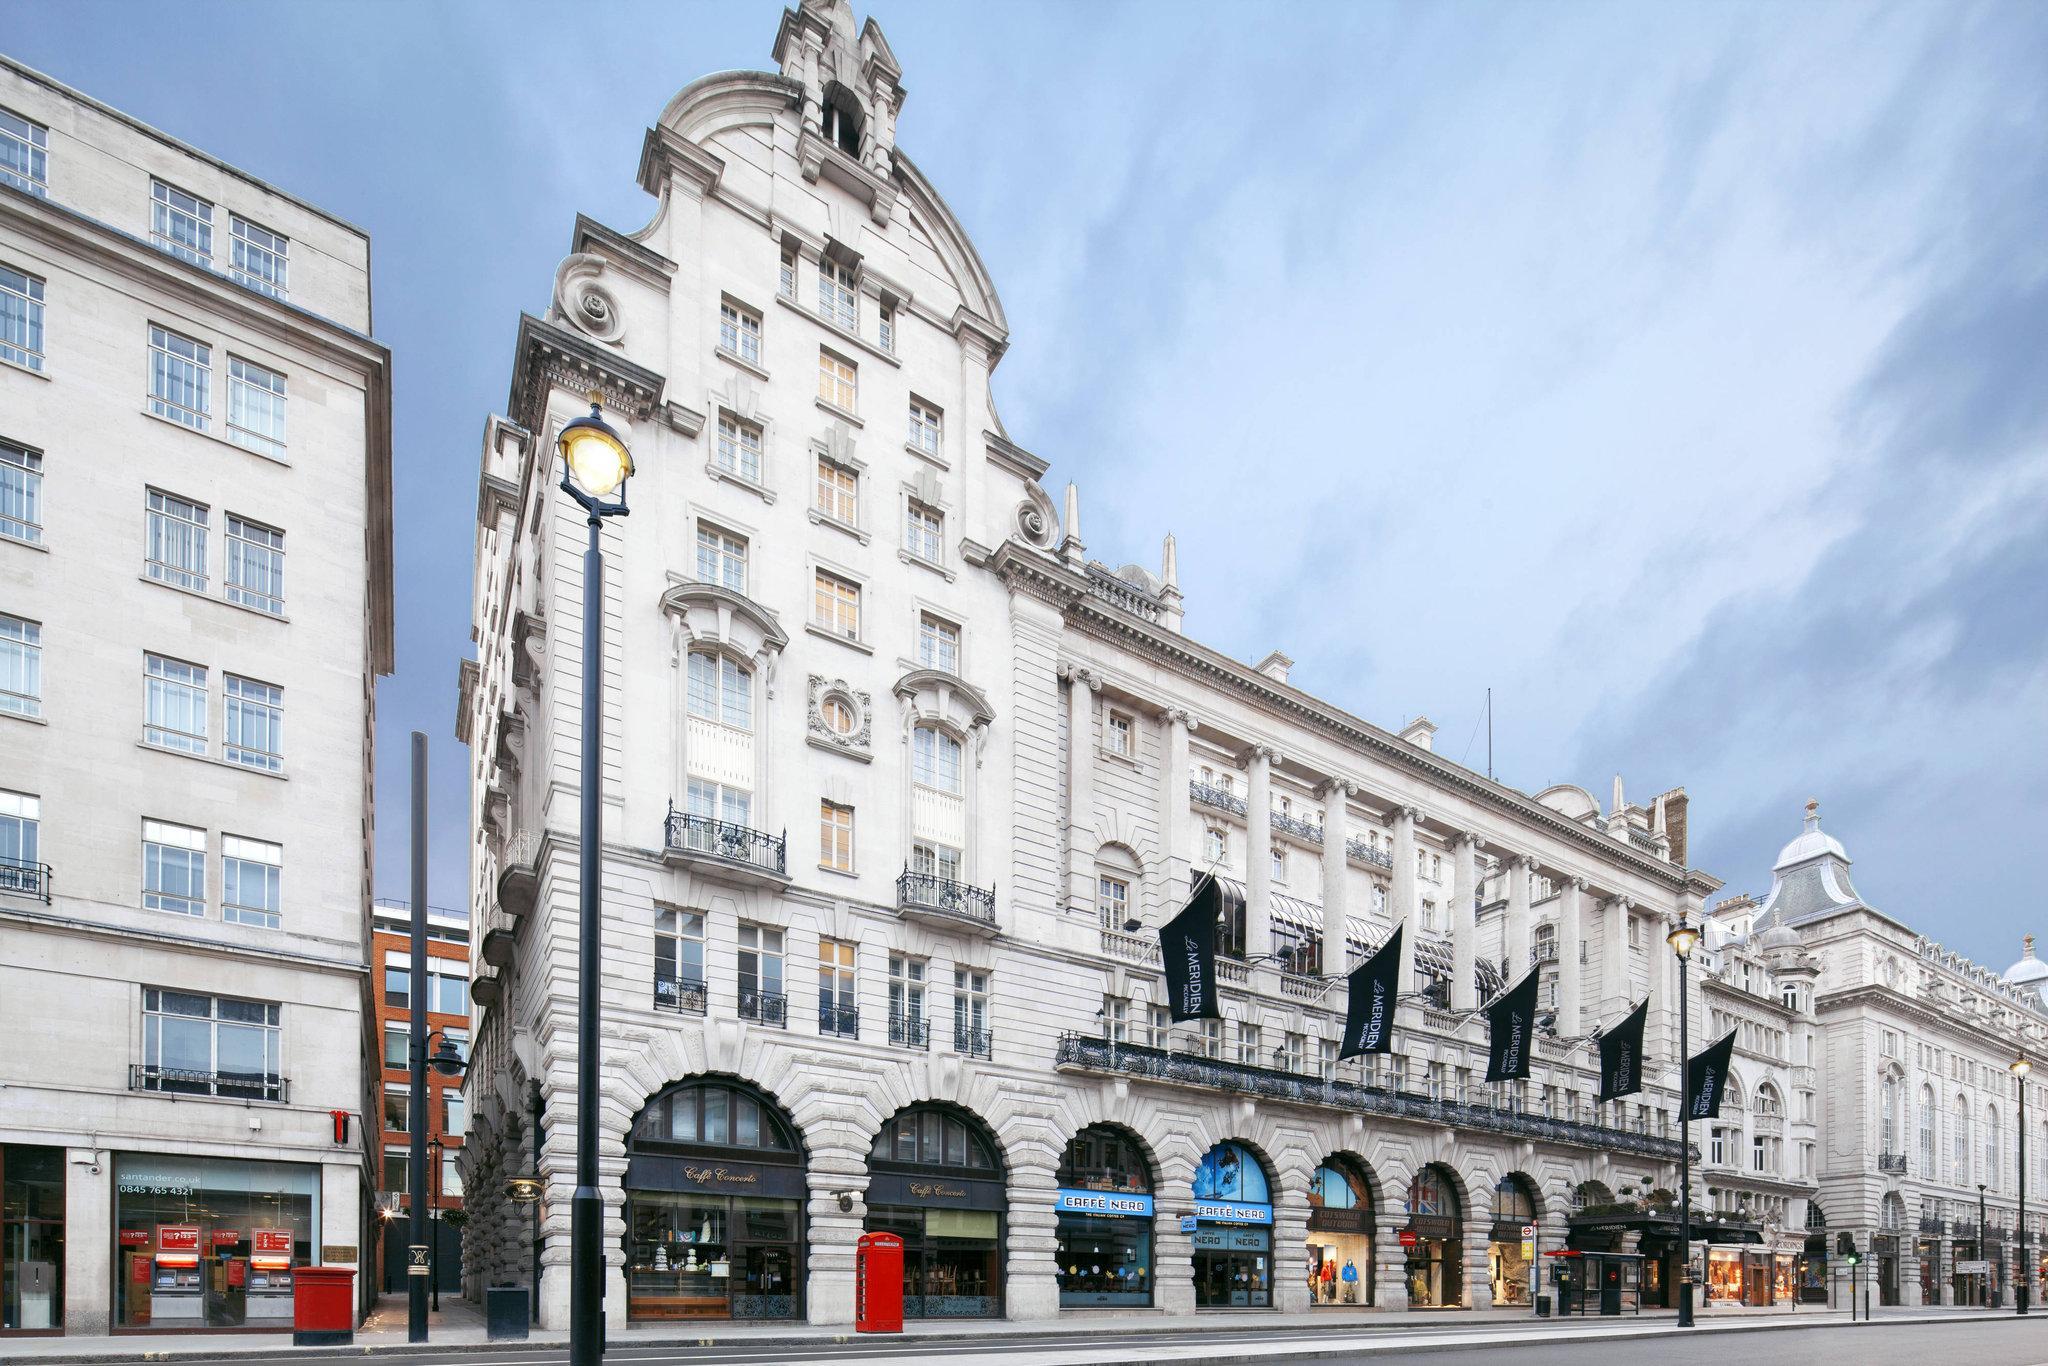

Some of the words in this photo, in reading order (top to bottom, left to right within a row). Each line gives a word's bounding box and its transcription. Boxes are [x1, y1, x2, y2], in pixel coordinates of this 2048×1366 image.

[1184, 935, 1198, 951] Le
[1187, 953, 1201, 1013] MERIDIEN
[1373, 979, 1385, 994] Le
[1365, 995, 1384, 1049] MERIDIEN
[1508, 1025, 1522, 1073] MERIDIEN
[1619, 1051, 1630, 1091] MERIDIEN
[1699, 1076, 1714, 1115] MERIDIEN
[120, 1173, 201, 1184] santander.co.uk
[715, 1168, 756, 1183] Concerto
[120, 1185, 146, 1194] 0845
[150, 1186, 167, 1195] 765
[169, 1187, 193, 1196] 4321
[933, 1184, 967, 1197] Concerto
[1110, 1200, 1146, 1211] NERO
[1236, 1208, 1265, 1219] NERO
[1320, 1210, 1361, 1220] COTSWOLD
[1194, 1235, 1220, 1245] NERO
[1235, 1238, 1260, 1247] NERO
